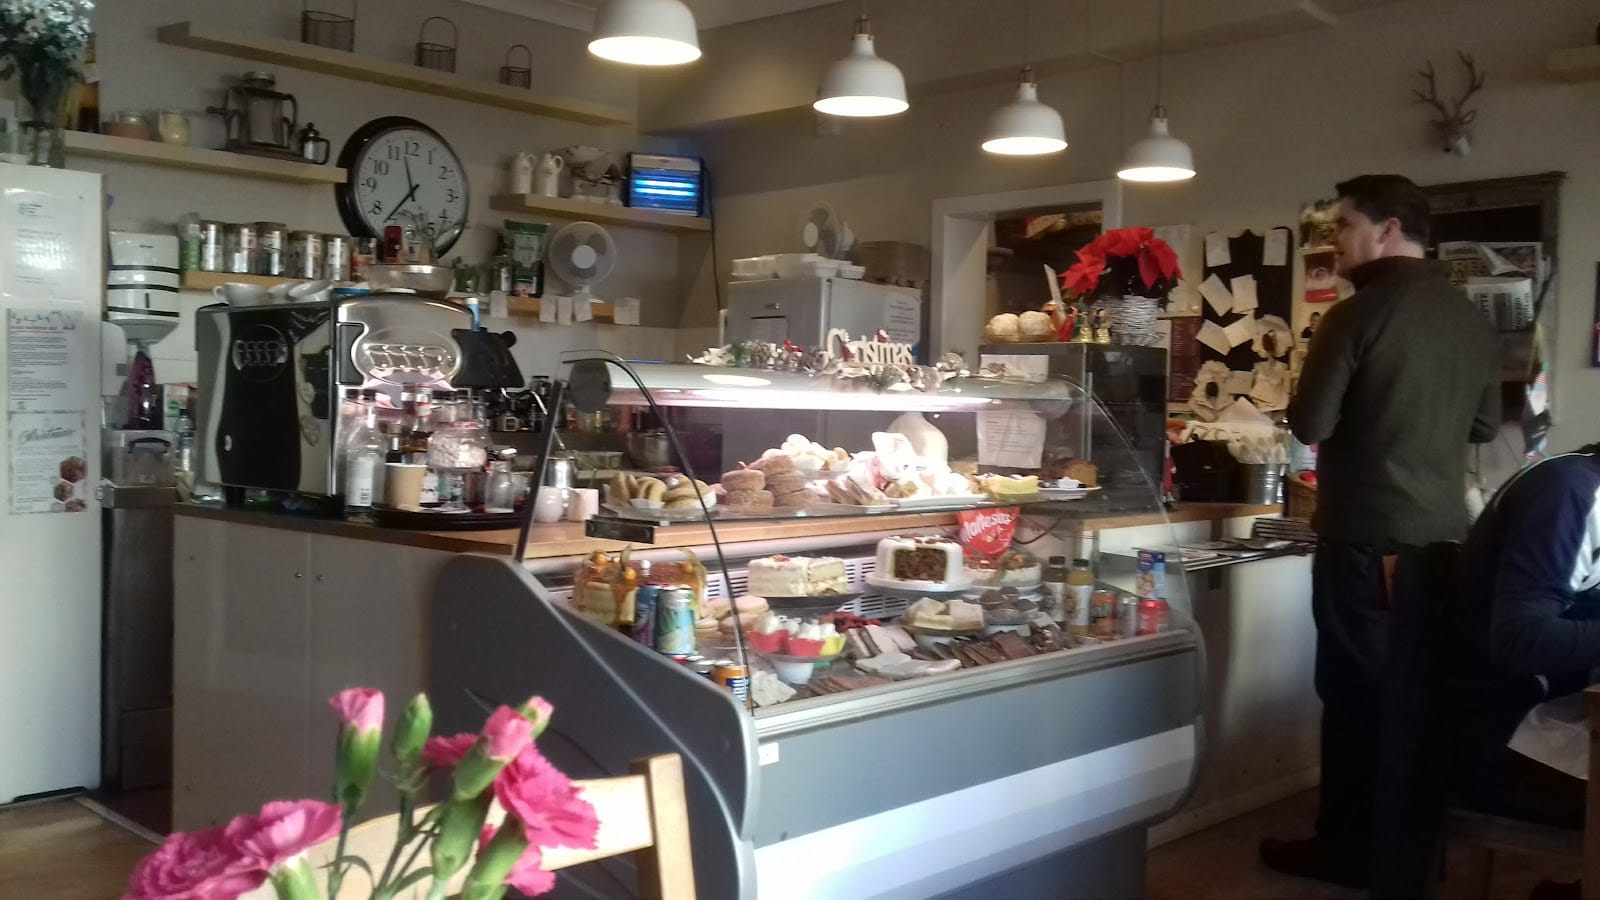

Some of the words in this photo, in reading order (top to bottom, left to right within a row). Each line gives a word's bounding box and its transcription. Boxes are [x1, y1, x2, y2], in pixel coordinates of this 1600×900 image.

[387, 145, 400, 160] 11
[404, 141, 420, 156] 12
[428, 150, 433, 164] 1
[374, 160, 389, 175] 10
[439, 166, 448, 179] 2
[366, 177, 377, 192] 9
[446, 188, 455, 202] 3
[372, 200, 383, 215] 8
[425, 222, 435, 237] 5
[827, 328, 913, 365] Cristmas
